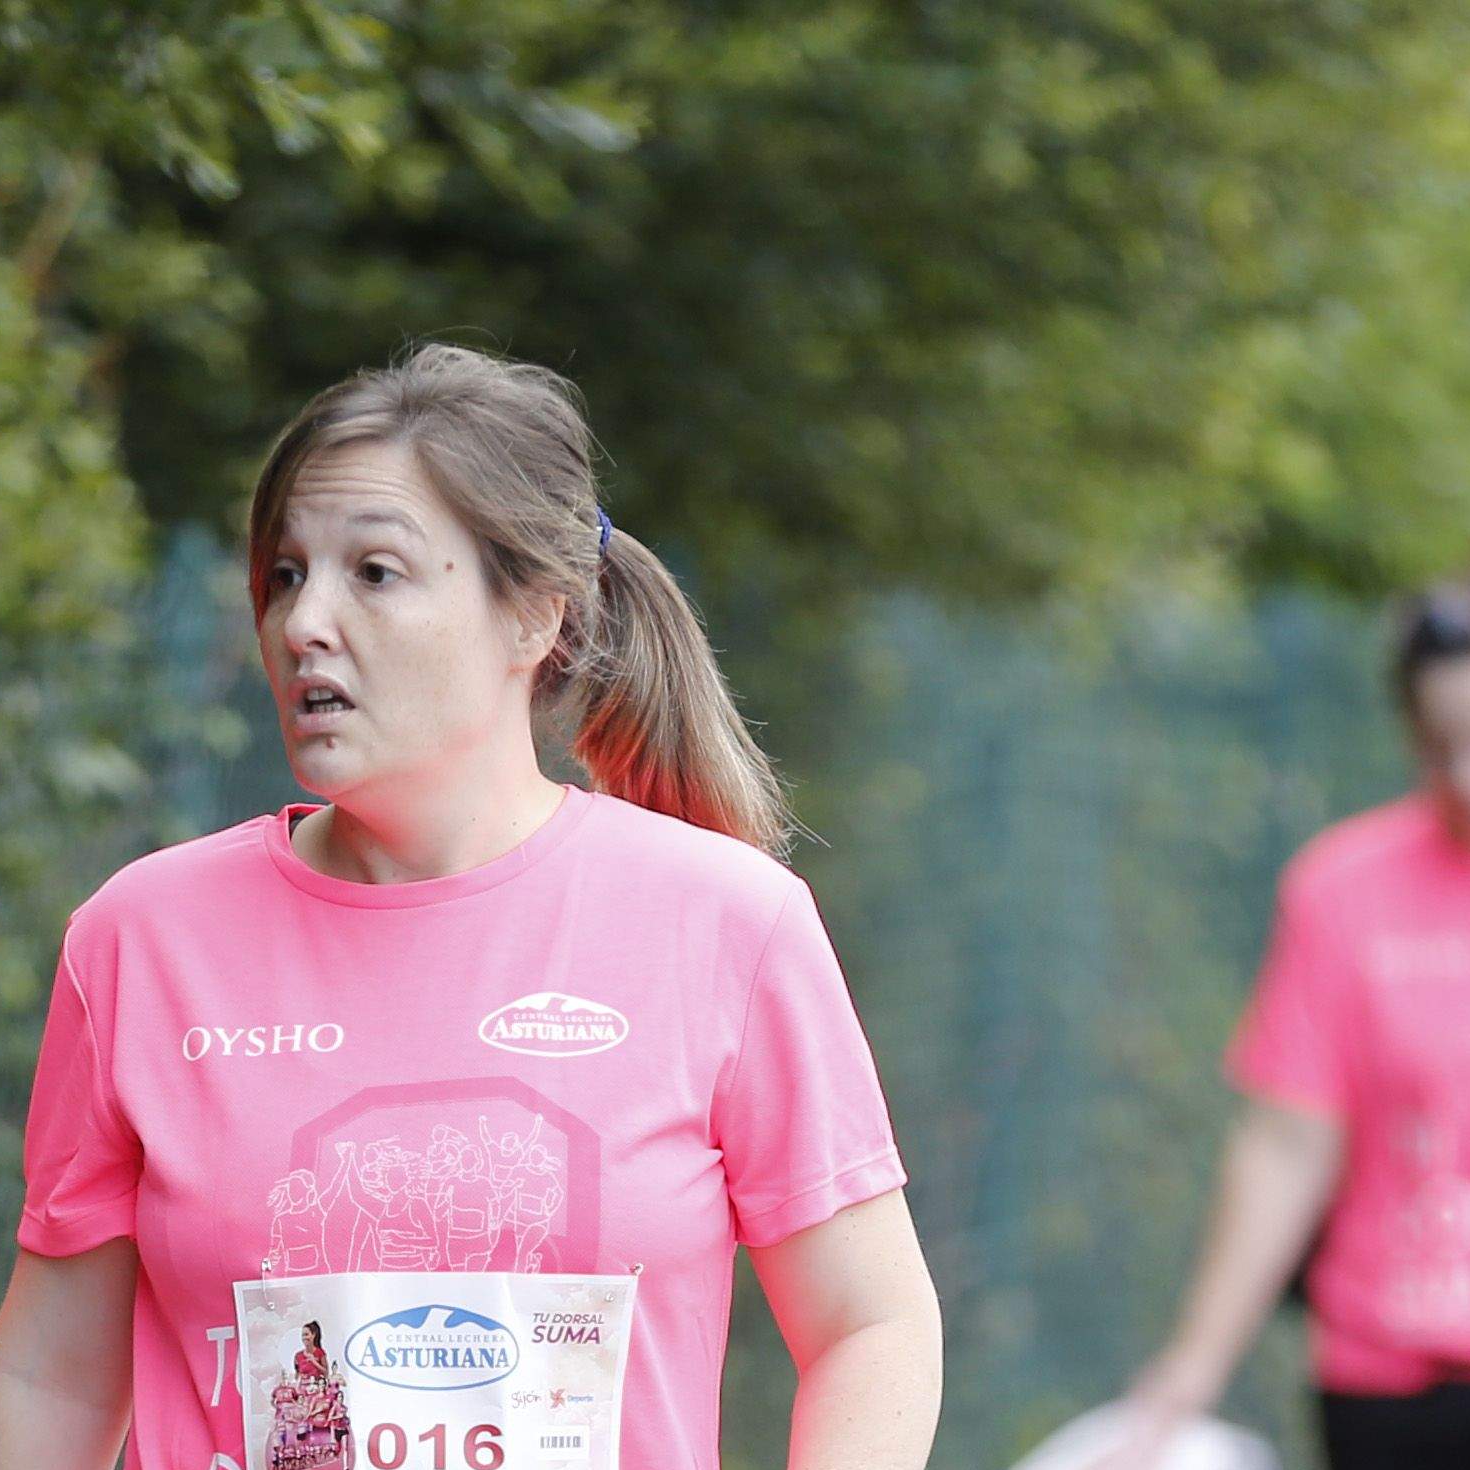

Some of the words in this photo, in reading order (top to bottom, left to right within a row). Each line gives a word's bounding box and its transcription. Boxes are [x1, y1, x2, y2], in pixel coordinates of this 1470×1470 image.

[490, 1016, 617, 1041] ASTURIANA
[182, 1023, 345, 1061] OYSHO
[532, 1313, 550, 1324] TU
[552, 1313, 604, 1325] DORSAL
[386, 1334, 443, 1343] CENTRAL
[449, 1334, 506, 1343] LECHERA
[531, 1325, 601, 1345] SUMA
[359, 1336, 510, 1369] ASTURIANA
